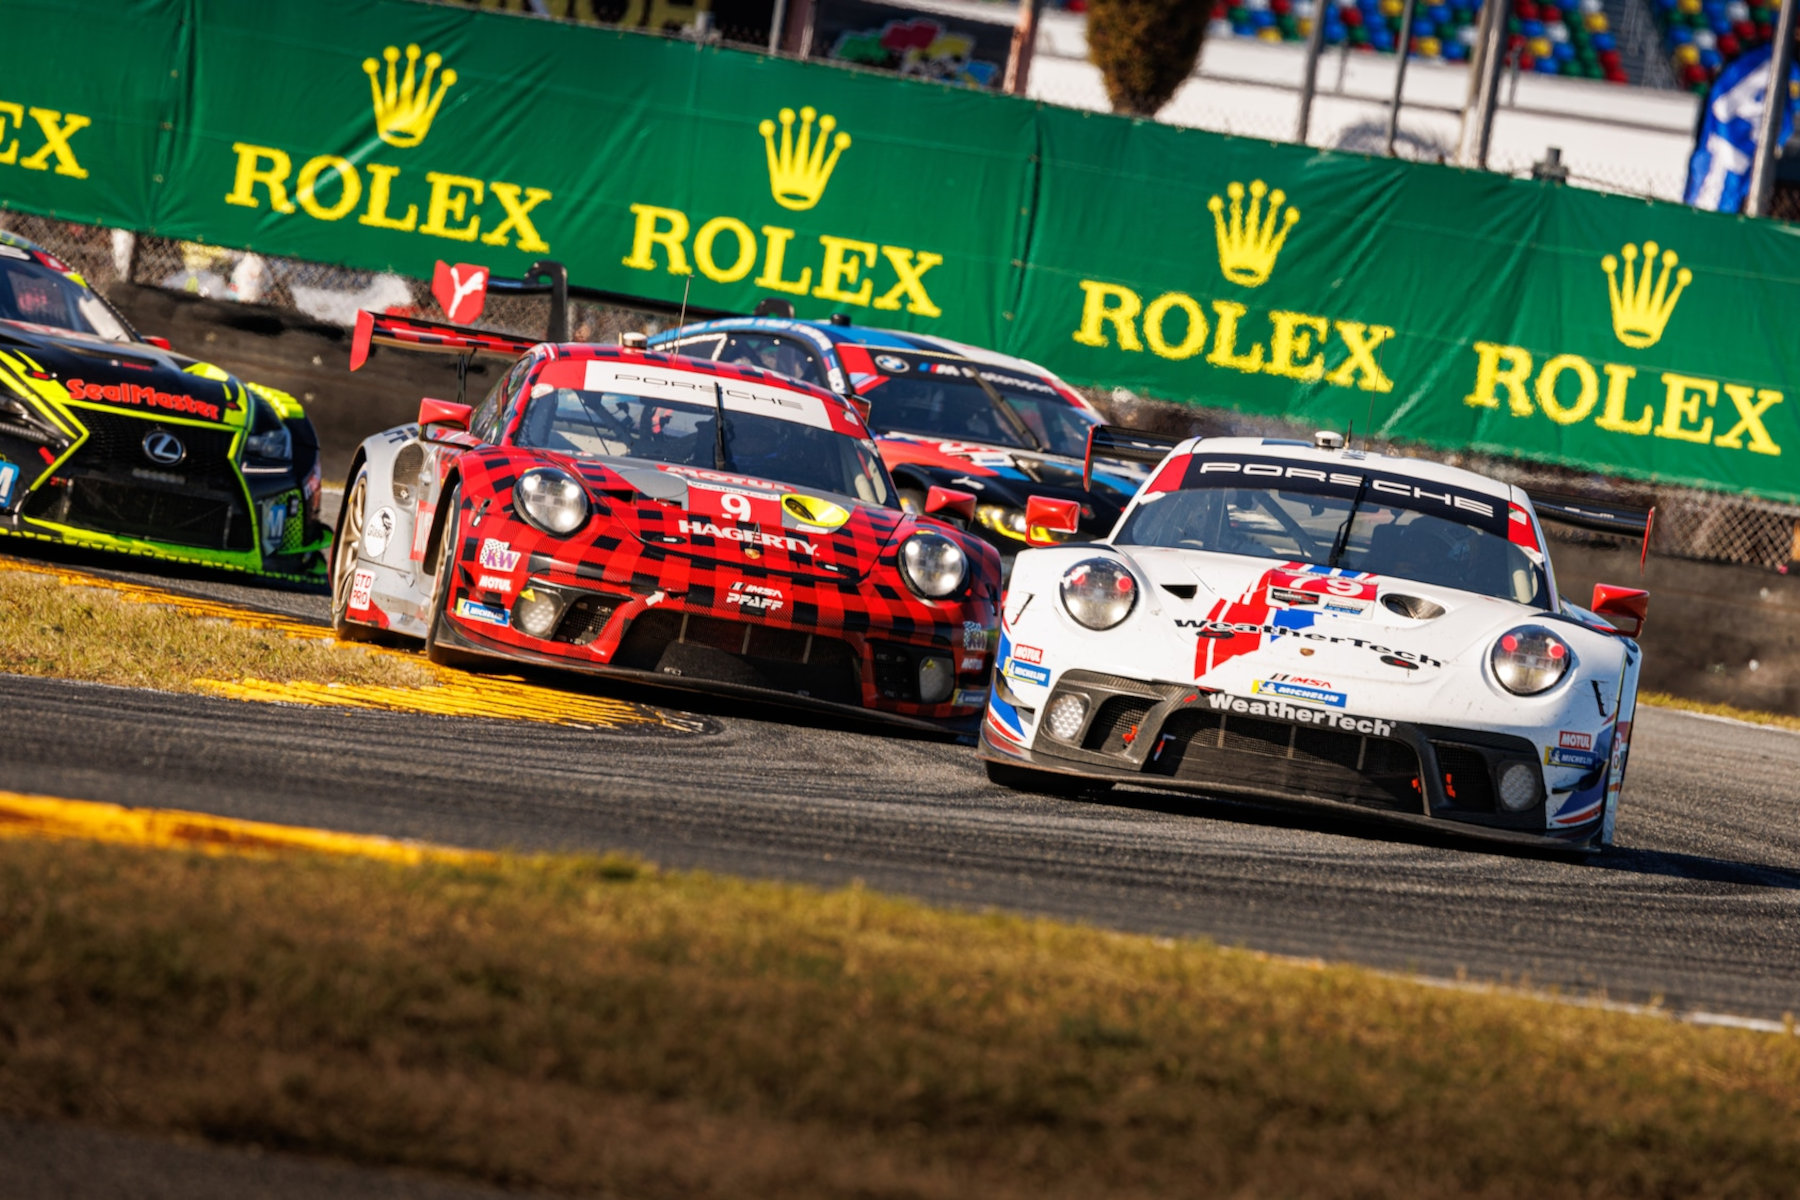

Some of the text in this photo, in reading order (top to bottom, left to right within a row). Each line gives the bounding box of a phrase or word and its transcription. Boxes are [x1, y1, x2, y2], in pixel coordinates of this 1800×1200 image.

[226, 143, 552, 253] ROLEX
[623, 204, 943, 318] ROLEX
[1074, 279, 1395, 393] ROLEX
[65, 378, 219, 420] SealMaster
[614, 373, 804, 411] PORSCHE
[1465, 341, 1783, 455] ROLEX
[665, 466, 793, 493] MOTUL
[1199, 461, 1494, 518] PORSCHE
[720, 493, 751, 522] 9
[485, 550, 518, 569] KW
[354, 572, 373, 588] GTD
[479, 575, 512, 592] MOTUL
[1288, 576, 1364, 597] 79
[352, 589, 368, 605] PRO
[726, 592, 784, 611] PFAFF
[744, 584, 783, 599] IMSA
[1173, 618, 1441, 669] WeatherTech
[1016, 646, 1041, 662] MOTUL
[1289, 676, 1332, 689] IMSA
[1277, 686, 1340, 703] MICHELIN
[1560, 733, 1591, 749] MOTUL
[1560, 753, 1594, 766] MICHELIN
